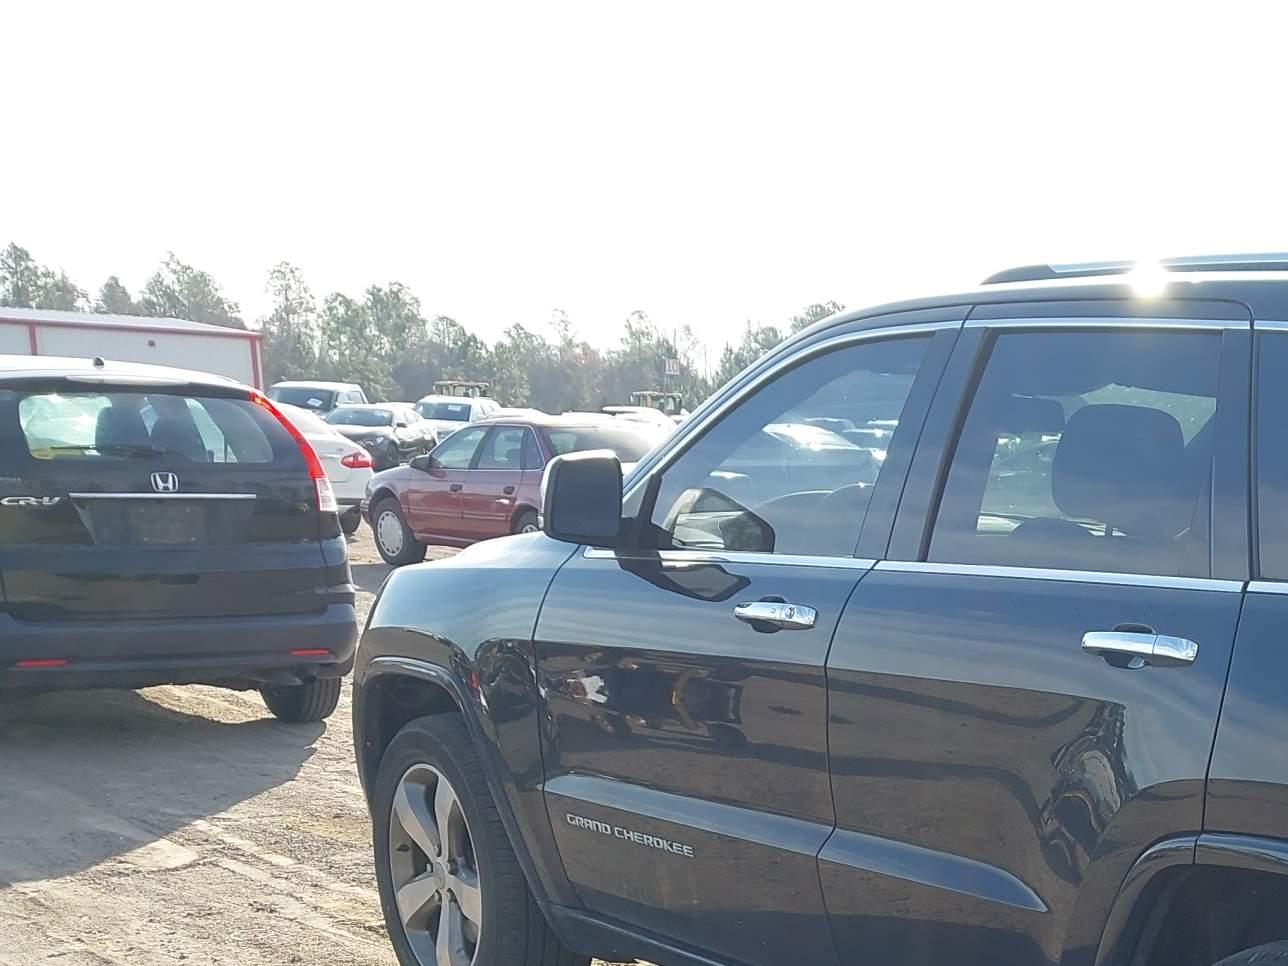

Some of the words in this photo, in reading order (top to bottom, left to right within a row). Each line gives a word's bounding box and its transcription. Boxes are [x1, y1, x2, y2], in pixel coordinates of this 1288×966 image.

[0, 496, 62, 506] CR-V
[565, 812, 612, 836] GRAND
[613, 825, 696, 858] CHEROKEE
